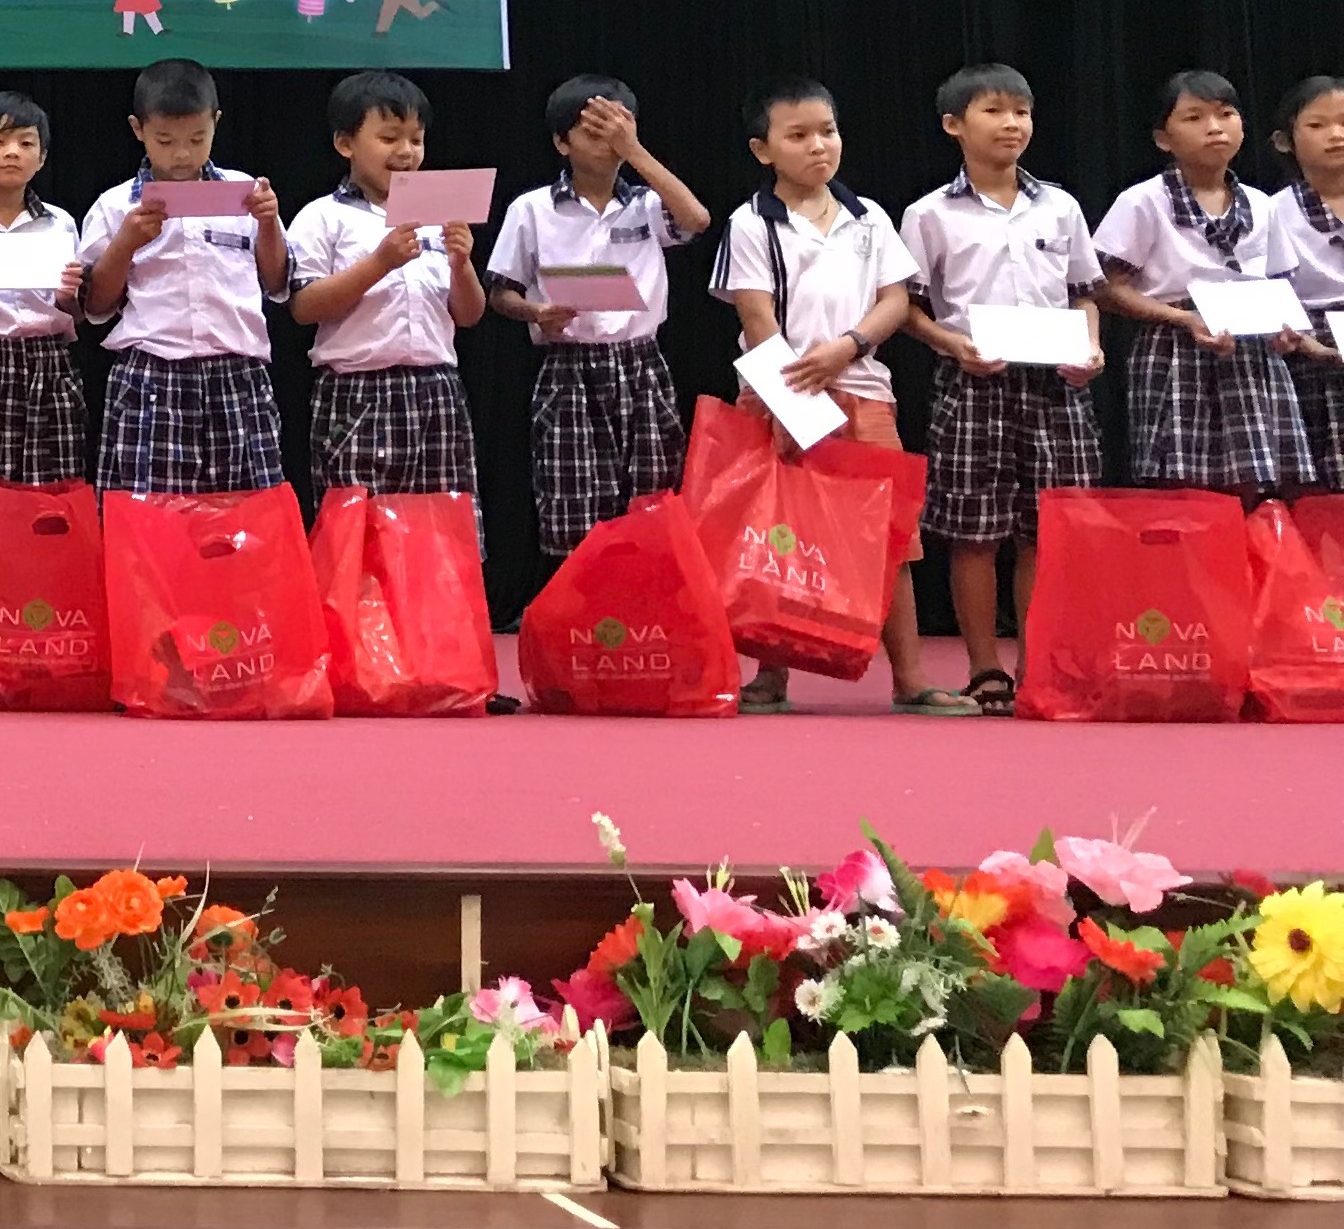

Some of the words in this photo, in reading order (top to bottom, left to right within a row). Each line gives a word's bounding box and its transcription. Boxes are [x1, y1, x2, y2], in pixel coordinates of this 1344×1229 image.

[740, 551, 826, 591] LAND
[193, 654, 275, 681] LAND
[572, 653, 670, 671] LAND
[1114, 653, 1211, 670] LAND
